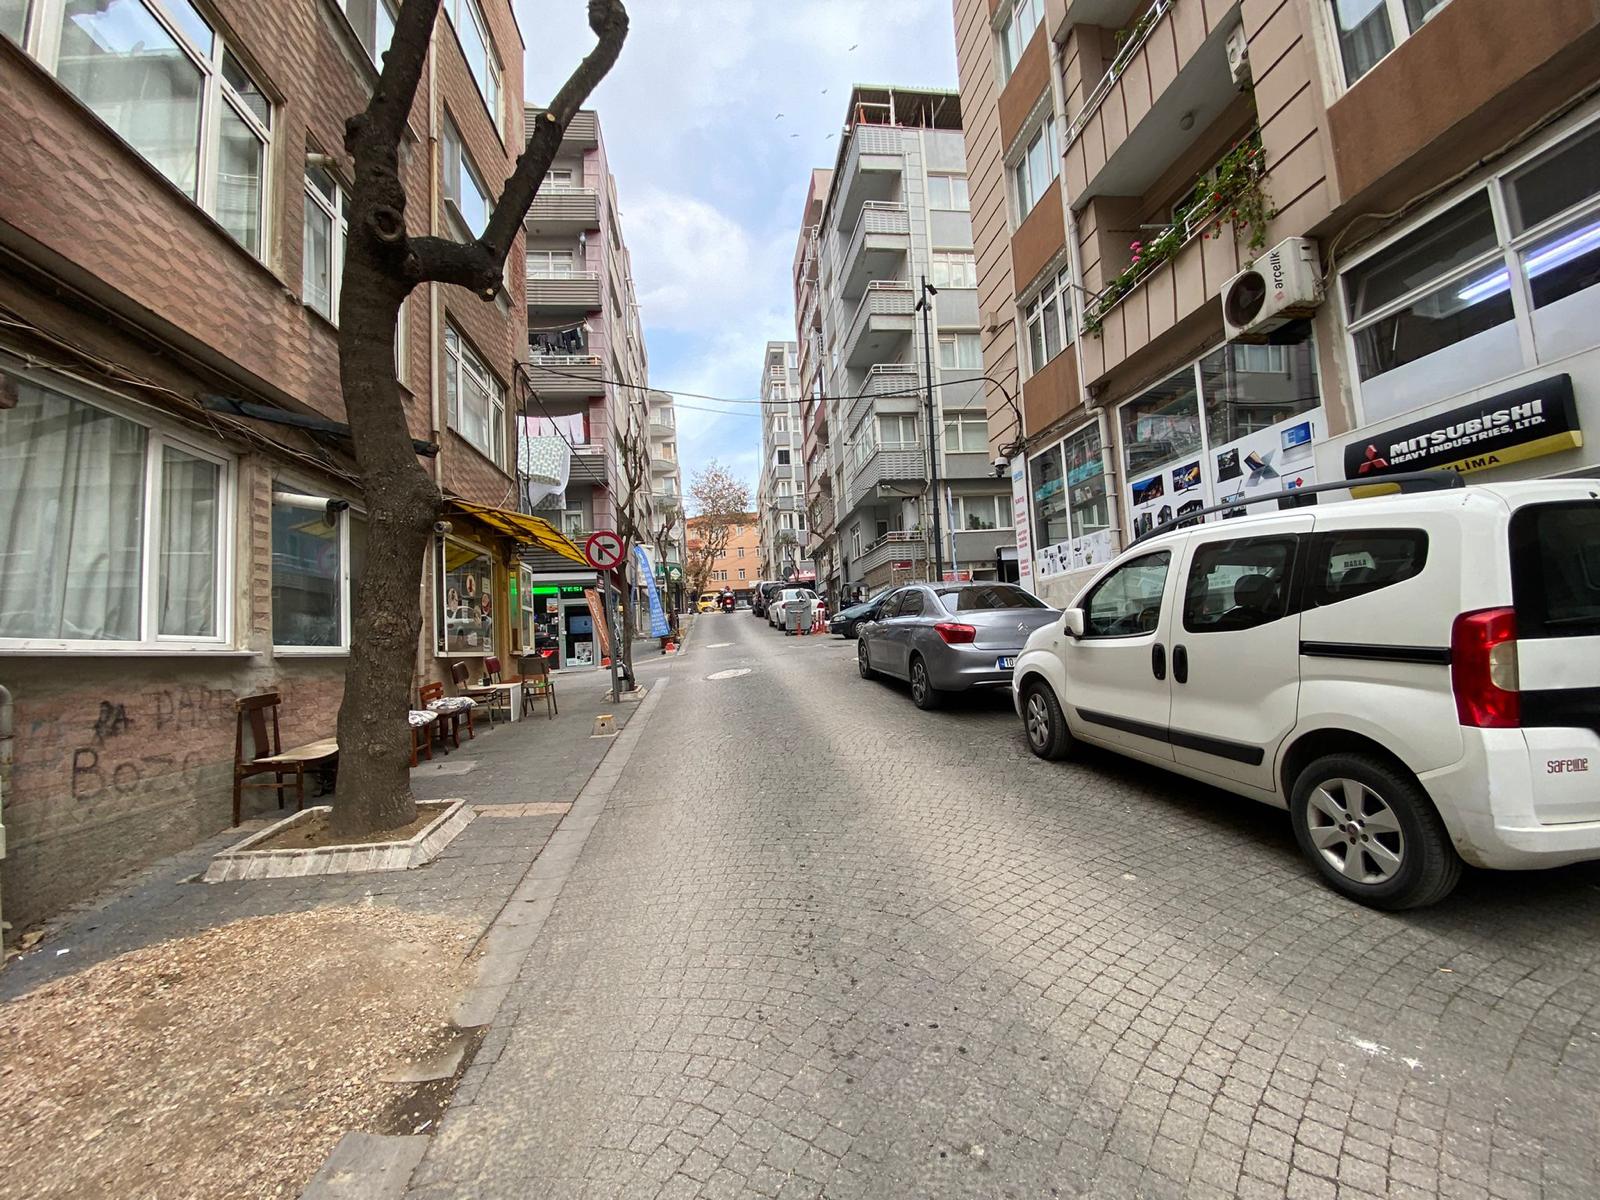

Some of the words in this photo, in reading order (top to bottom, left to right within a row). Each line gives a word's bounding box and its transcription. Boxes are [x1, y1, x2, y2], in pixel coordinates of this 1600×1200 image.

[1270, 251, 1285, 289] arçelik
[1390, 399, 1543, 458] MITSUBISHI
[1390, 448, 1427, 465] HEAVY
[1429, 424, 1514, 454] INDUSTRIES,
[1515, 416, 1546, 430] LTD.
